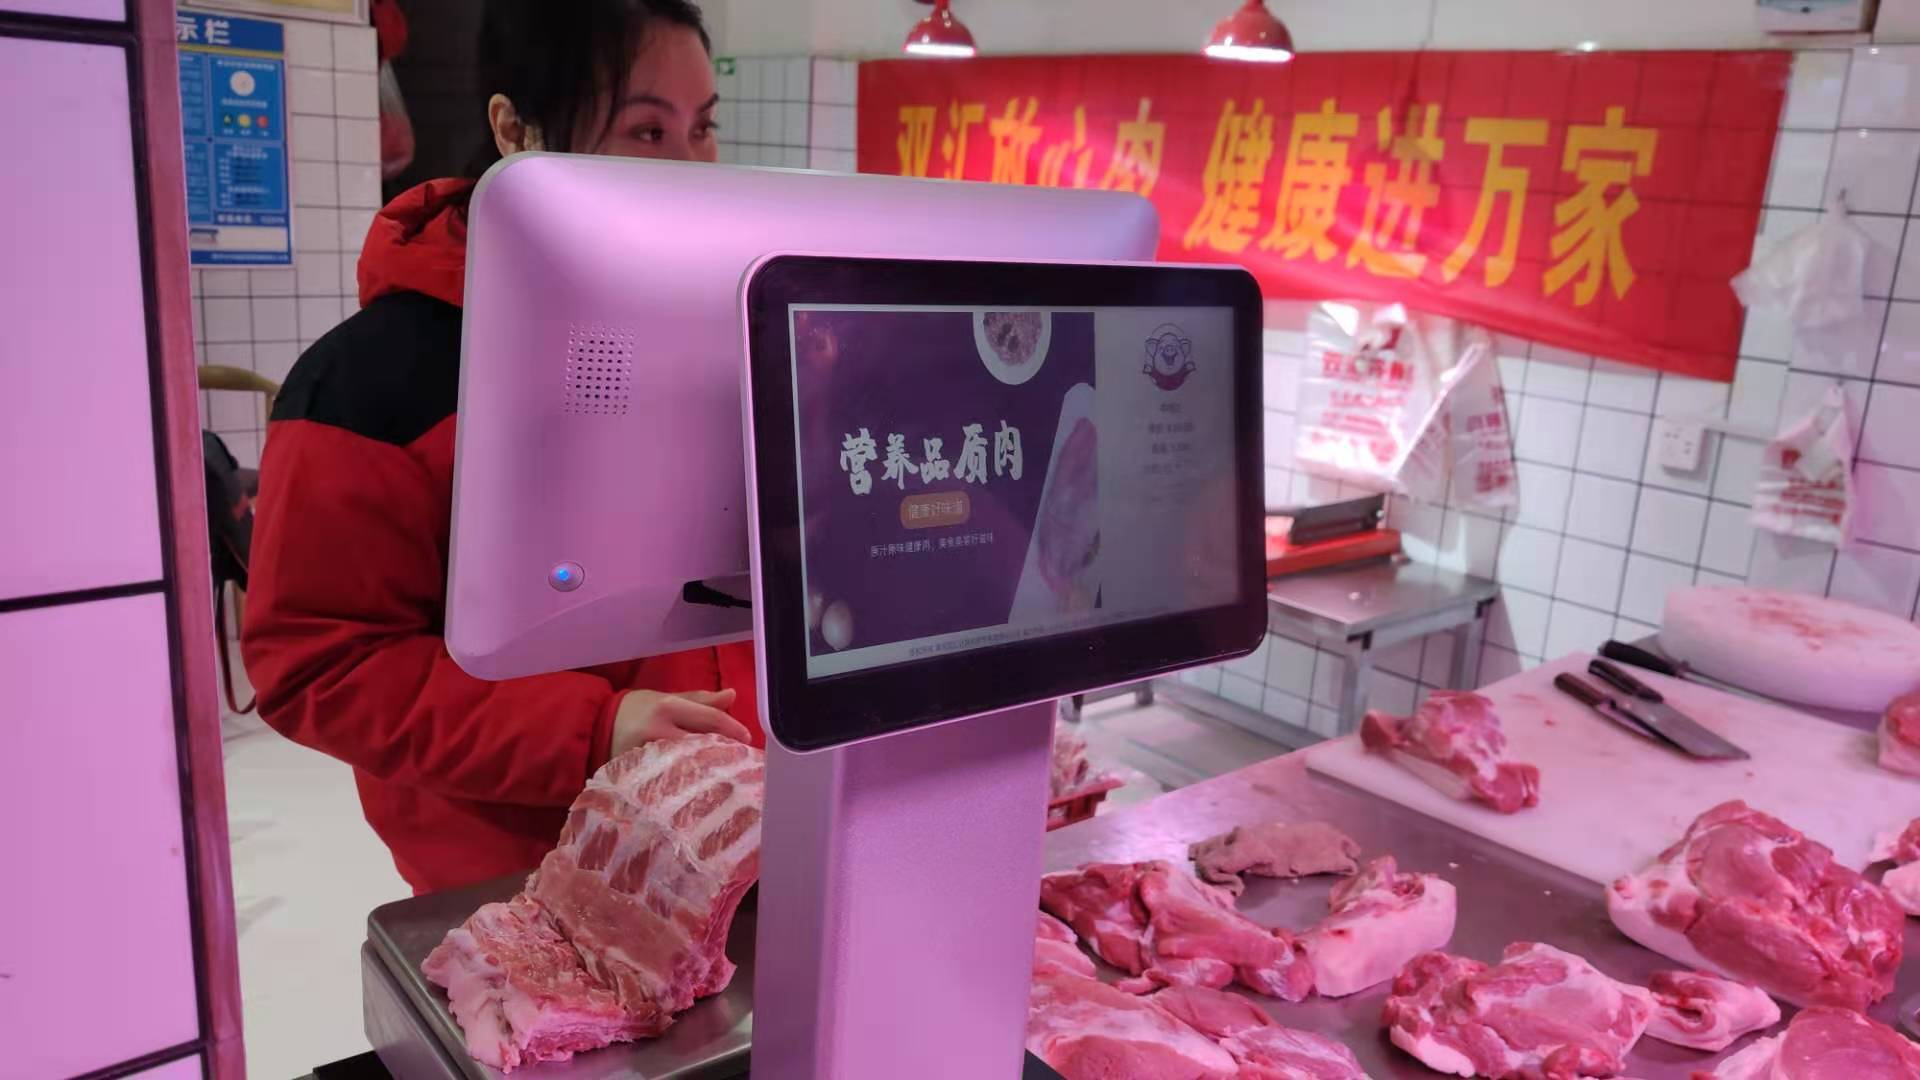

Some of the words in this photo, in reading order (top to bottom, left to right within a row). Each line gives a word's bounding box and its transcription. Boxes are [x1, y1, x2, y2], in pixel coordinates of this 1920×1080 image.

[897, 97, 1166, 197] 双汇放心肉
[1183, 97, 1659, 306] 健康进万家
[840, 420, 1023, 495] 营养品质肉
